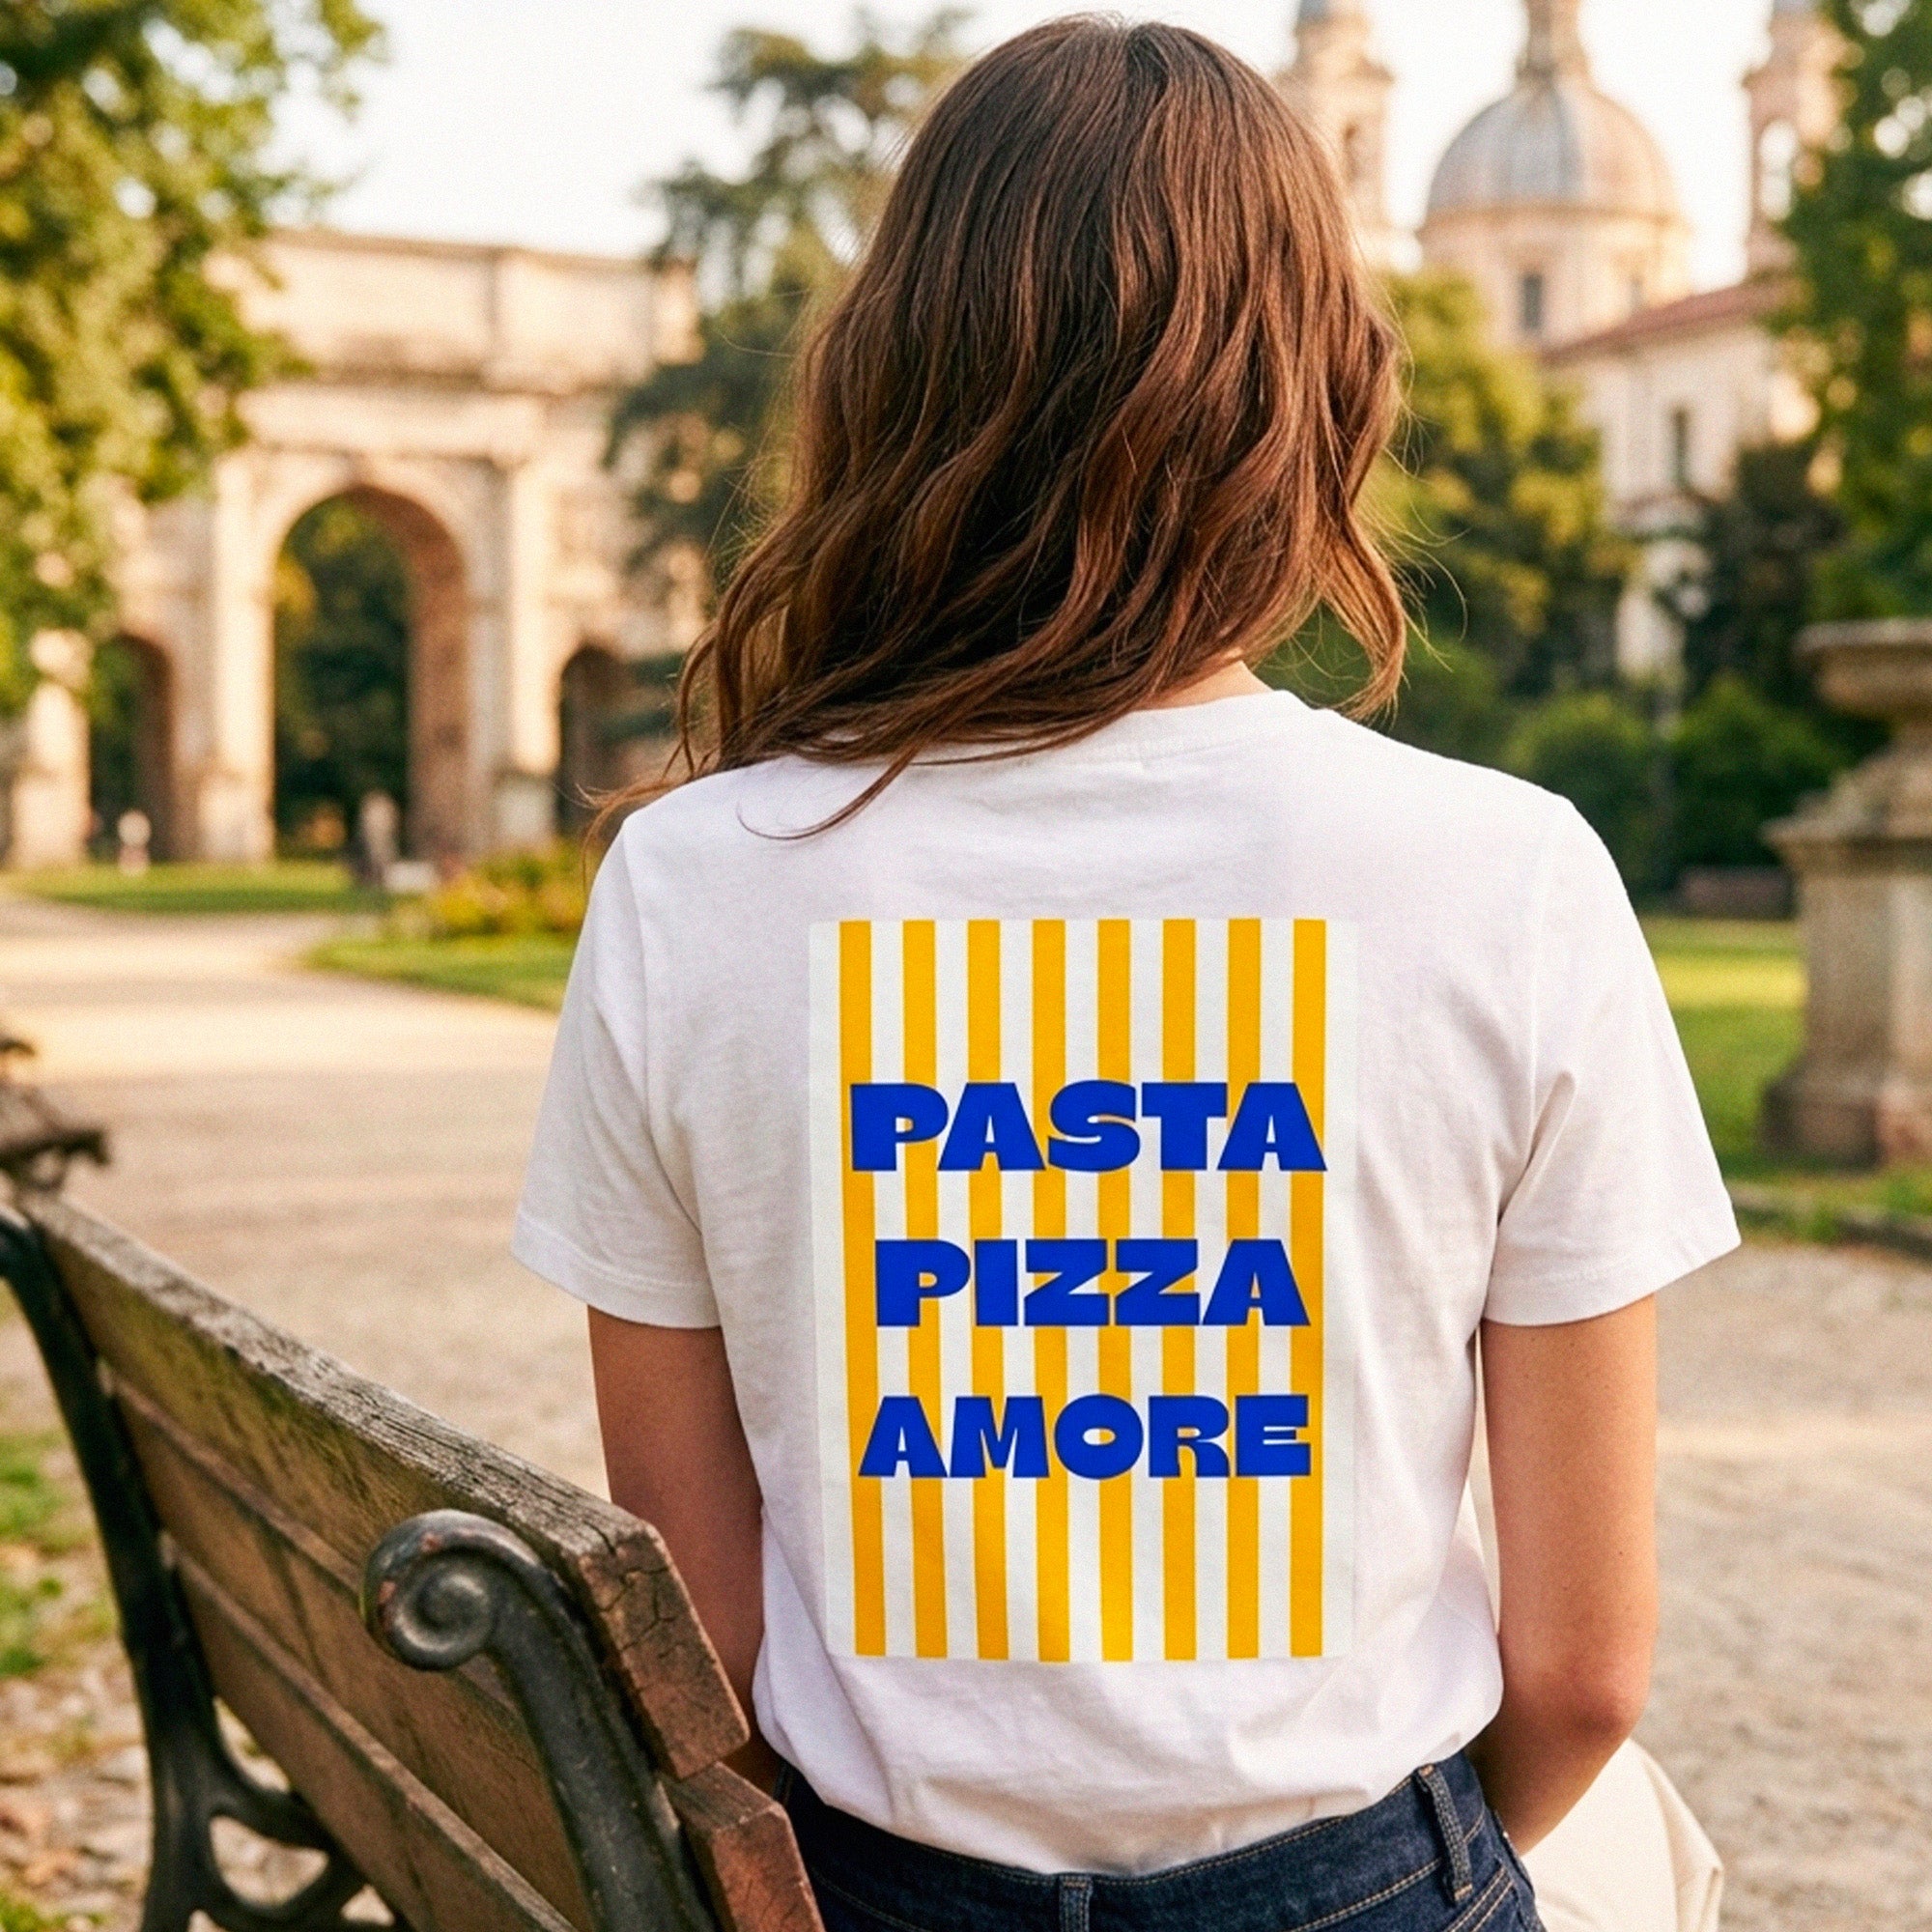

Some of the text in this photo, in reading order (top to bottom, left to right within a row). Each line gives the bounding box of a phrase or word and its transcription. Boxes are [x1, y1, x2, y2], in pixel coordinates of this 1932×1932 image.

[850, 1080, 1326, 1172] PASTA
[875, 1238, 1309, 1327] PIZZA
[858, 1394, 1312, 1479] AMORE
